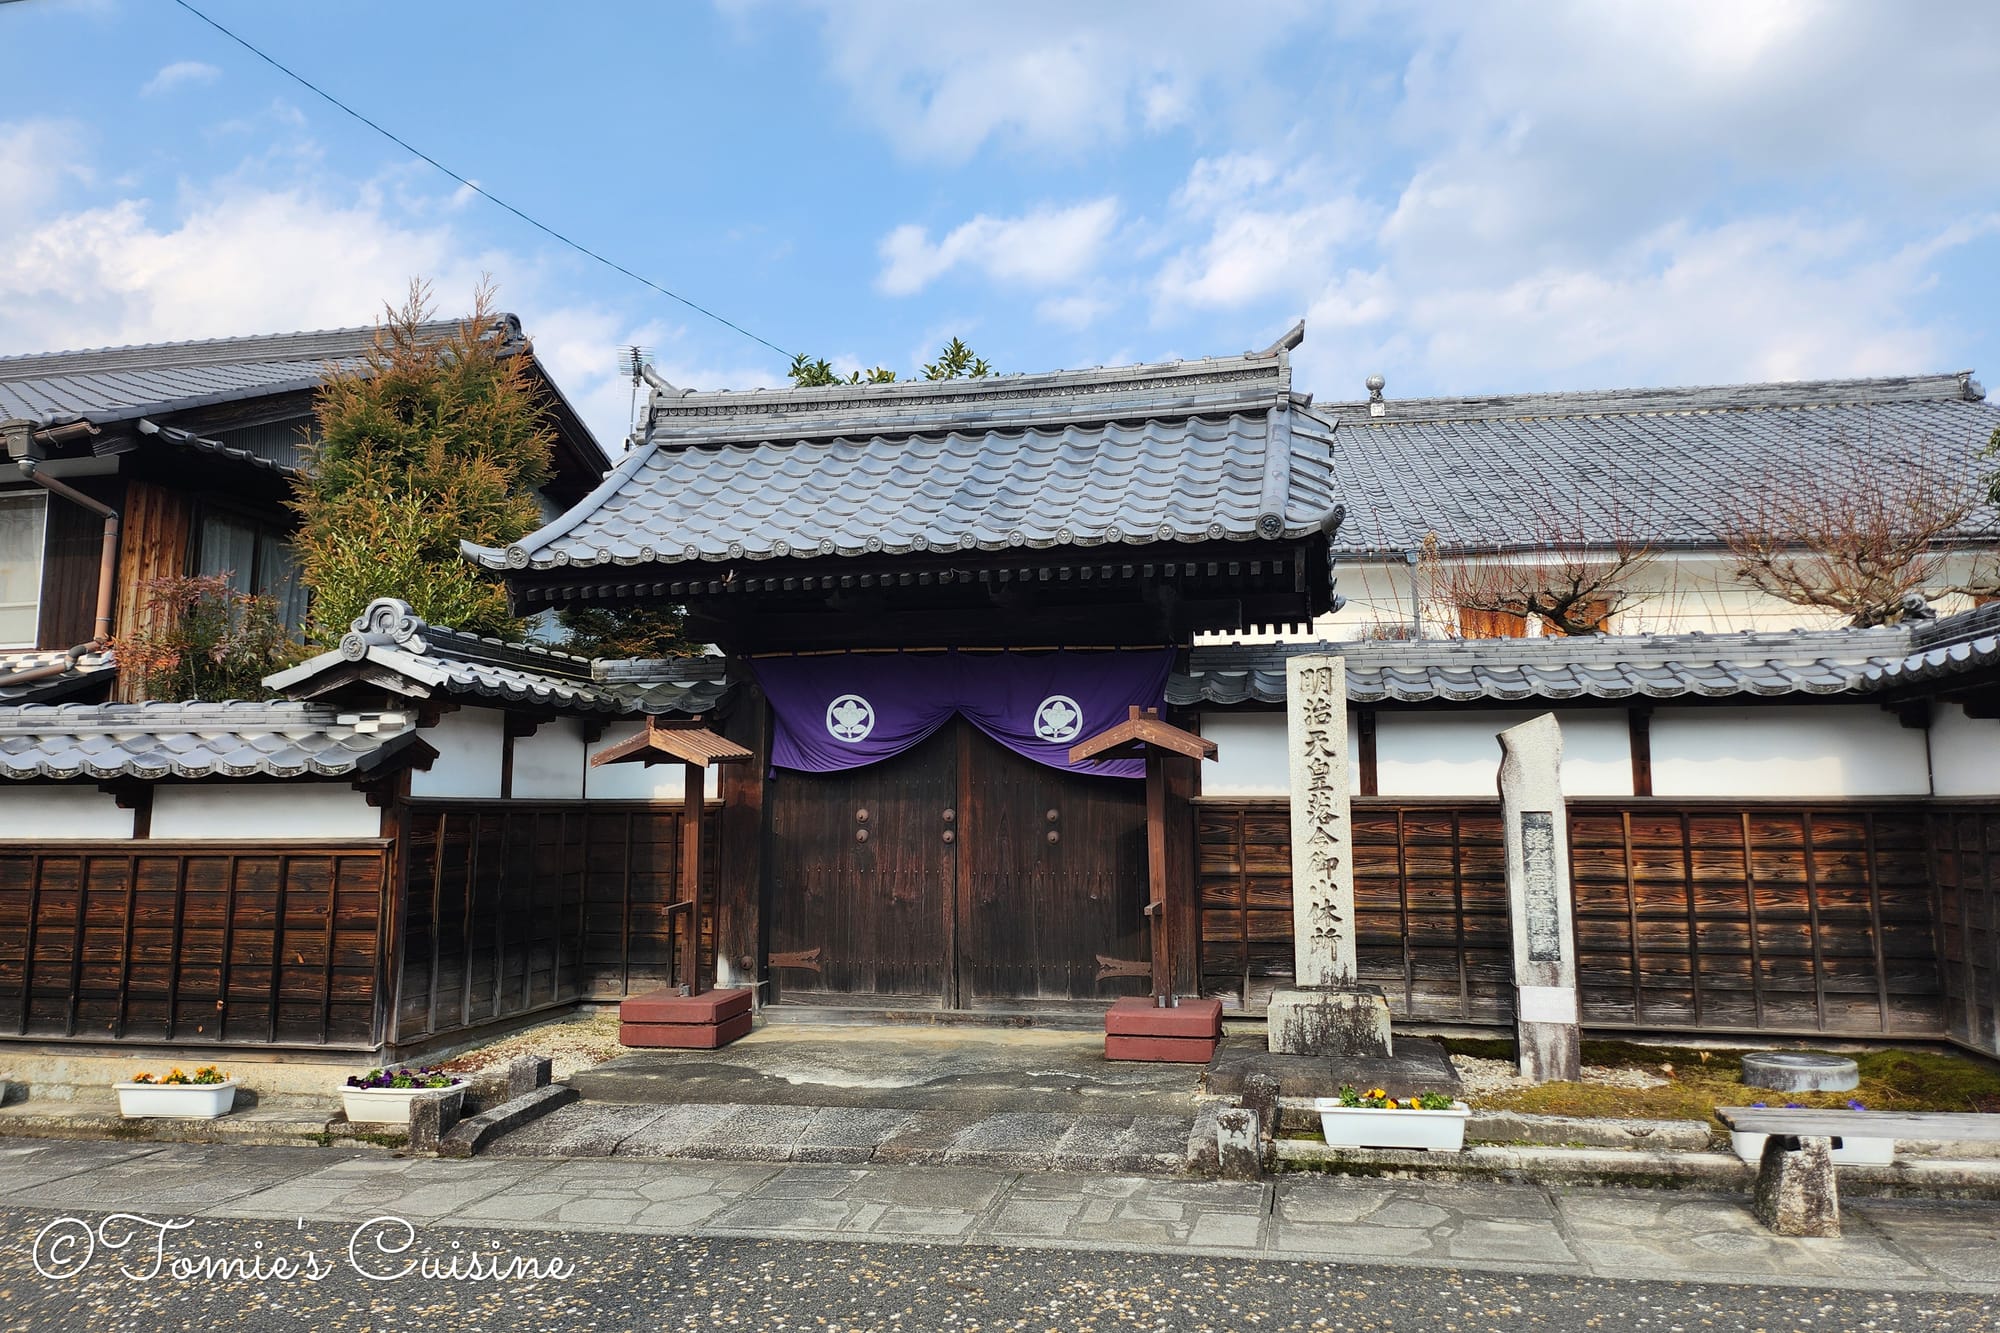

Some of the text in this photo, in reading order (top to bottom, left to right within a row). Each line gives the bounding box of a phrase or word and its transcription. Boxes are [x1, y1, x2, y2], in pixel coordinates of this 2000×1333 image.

[1299, 666, 1343, 962] 明治天皇落合御小休所
